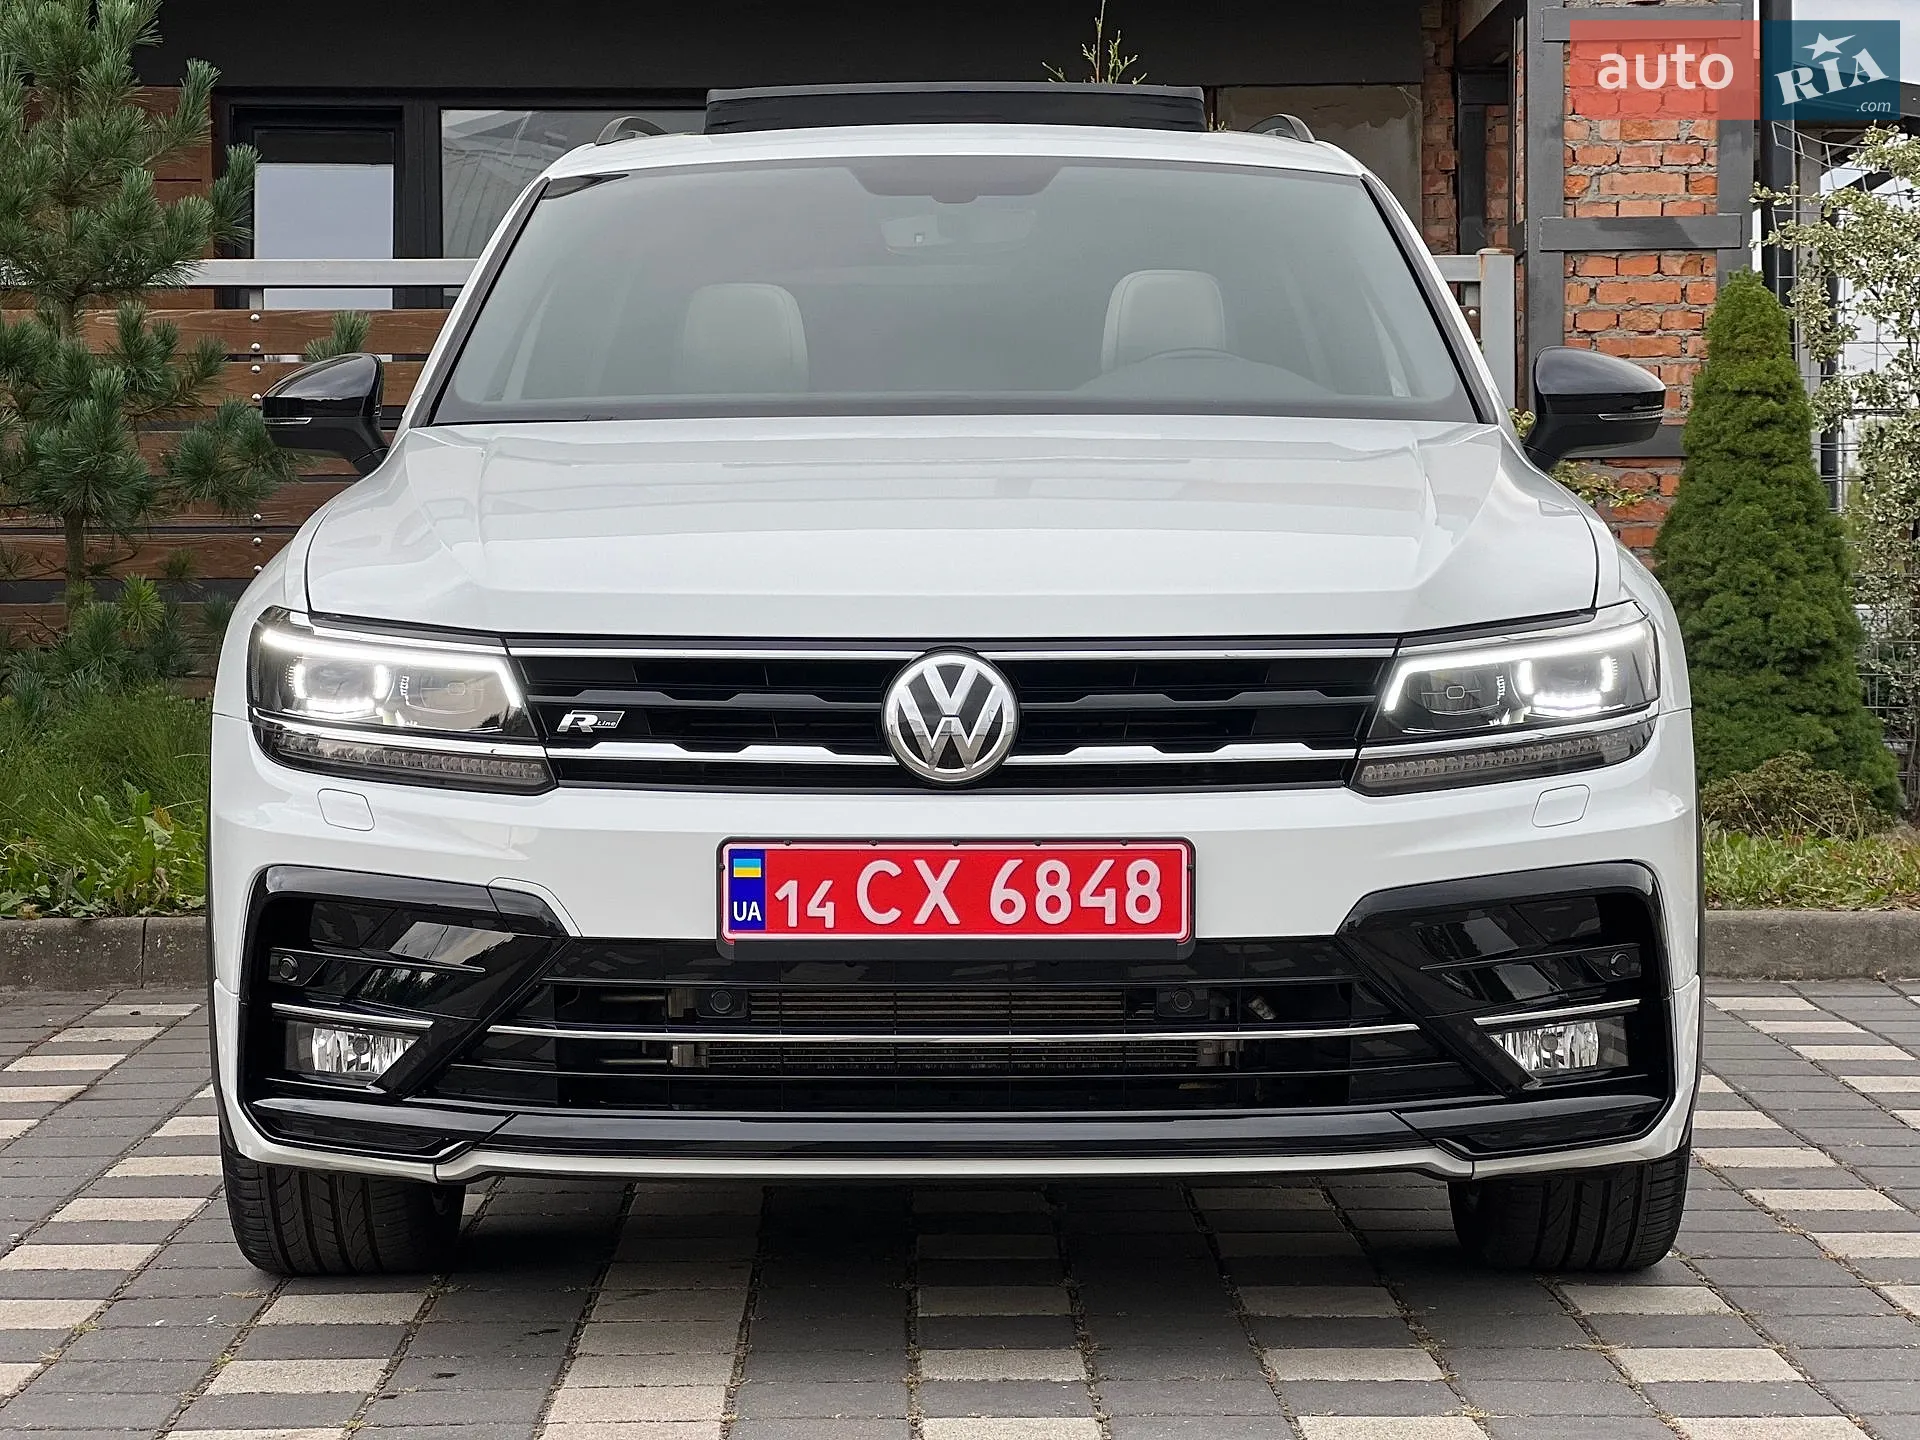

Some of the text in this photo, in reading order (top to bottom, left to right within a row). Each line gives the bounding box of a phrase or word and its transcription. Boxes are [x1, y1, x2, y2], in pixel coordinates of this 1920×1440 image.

[733, 902, 762, 921] UA
[774, 859, 1162, 928] 14 CX 6848
